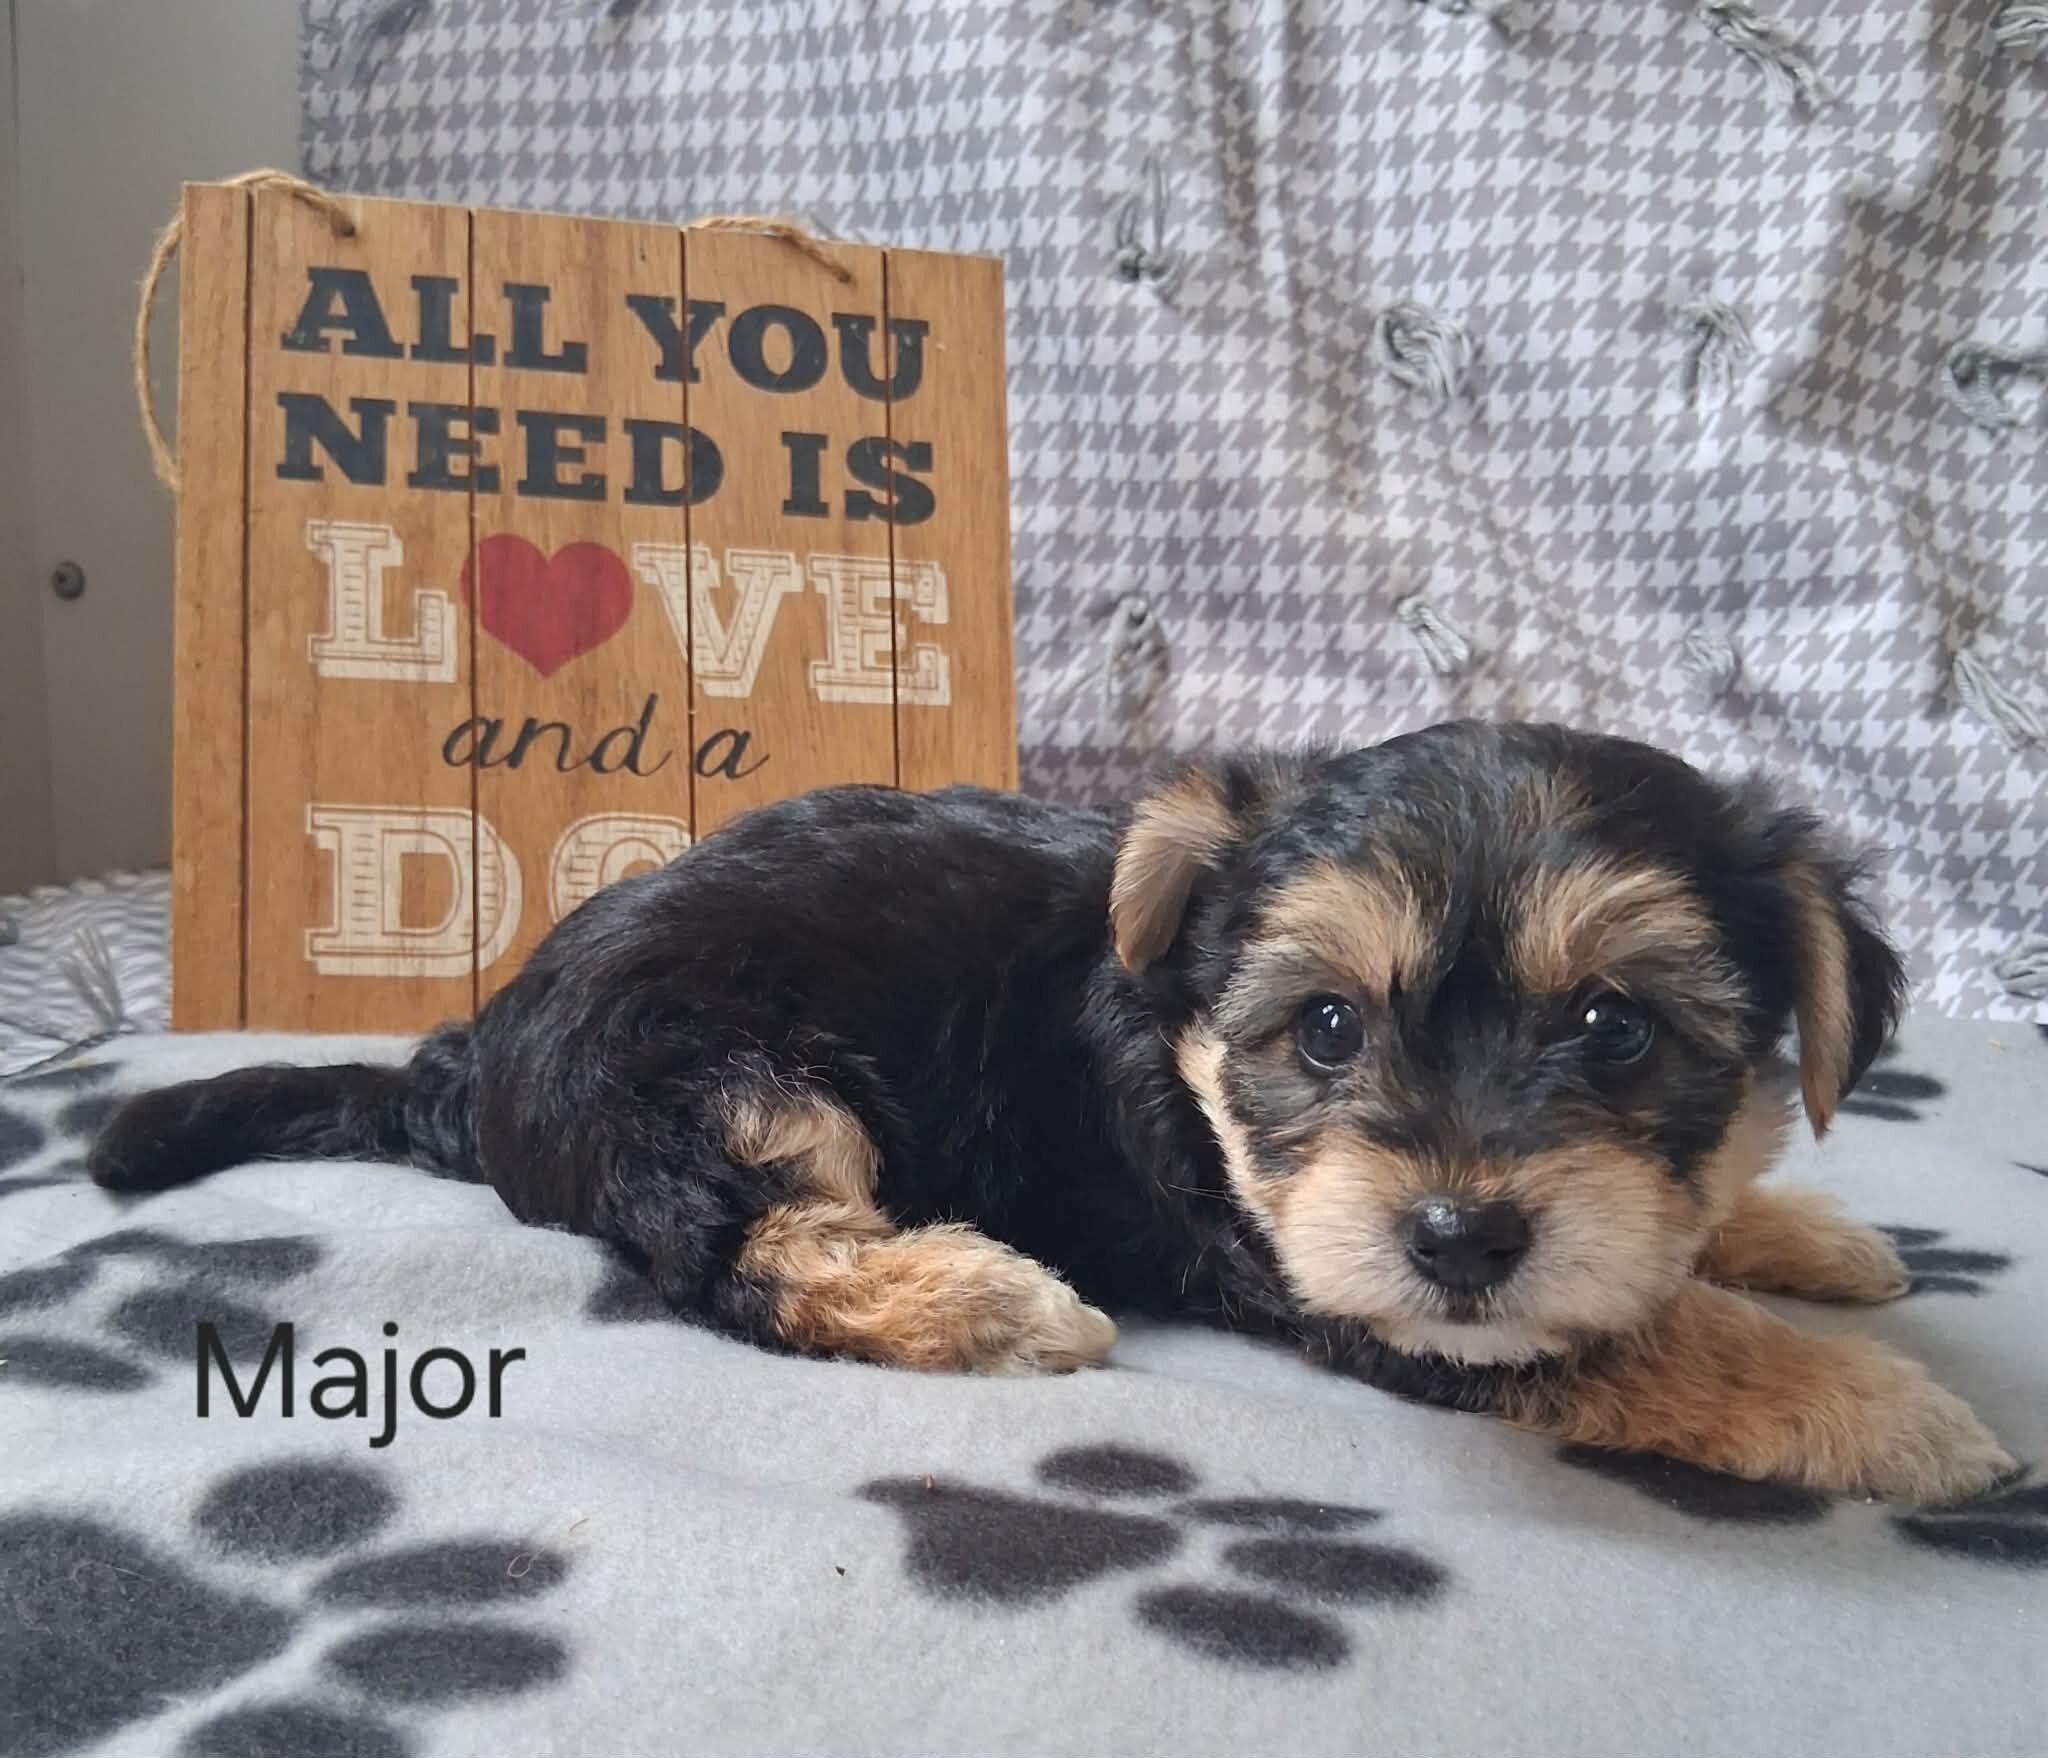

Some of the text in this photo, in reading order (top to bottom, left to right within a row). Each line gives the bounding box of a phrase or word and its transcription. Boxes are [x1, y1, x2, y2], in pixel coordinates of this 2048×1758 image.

[281, 267, 931, 402] ALL YOU
[276, 392, 937, 527] NEED IS
[442, 693, 771, 779] and a
